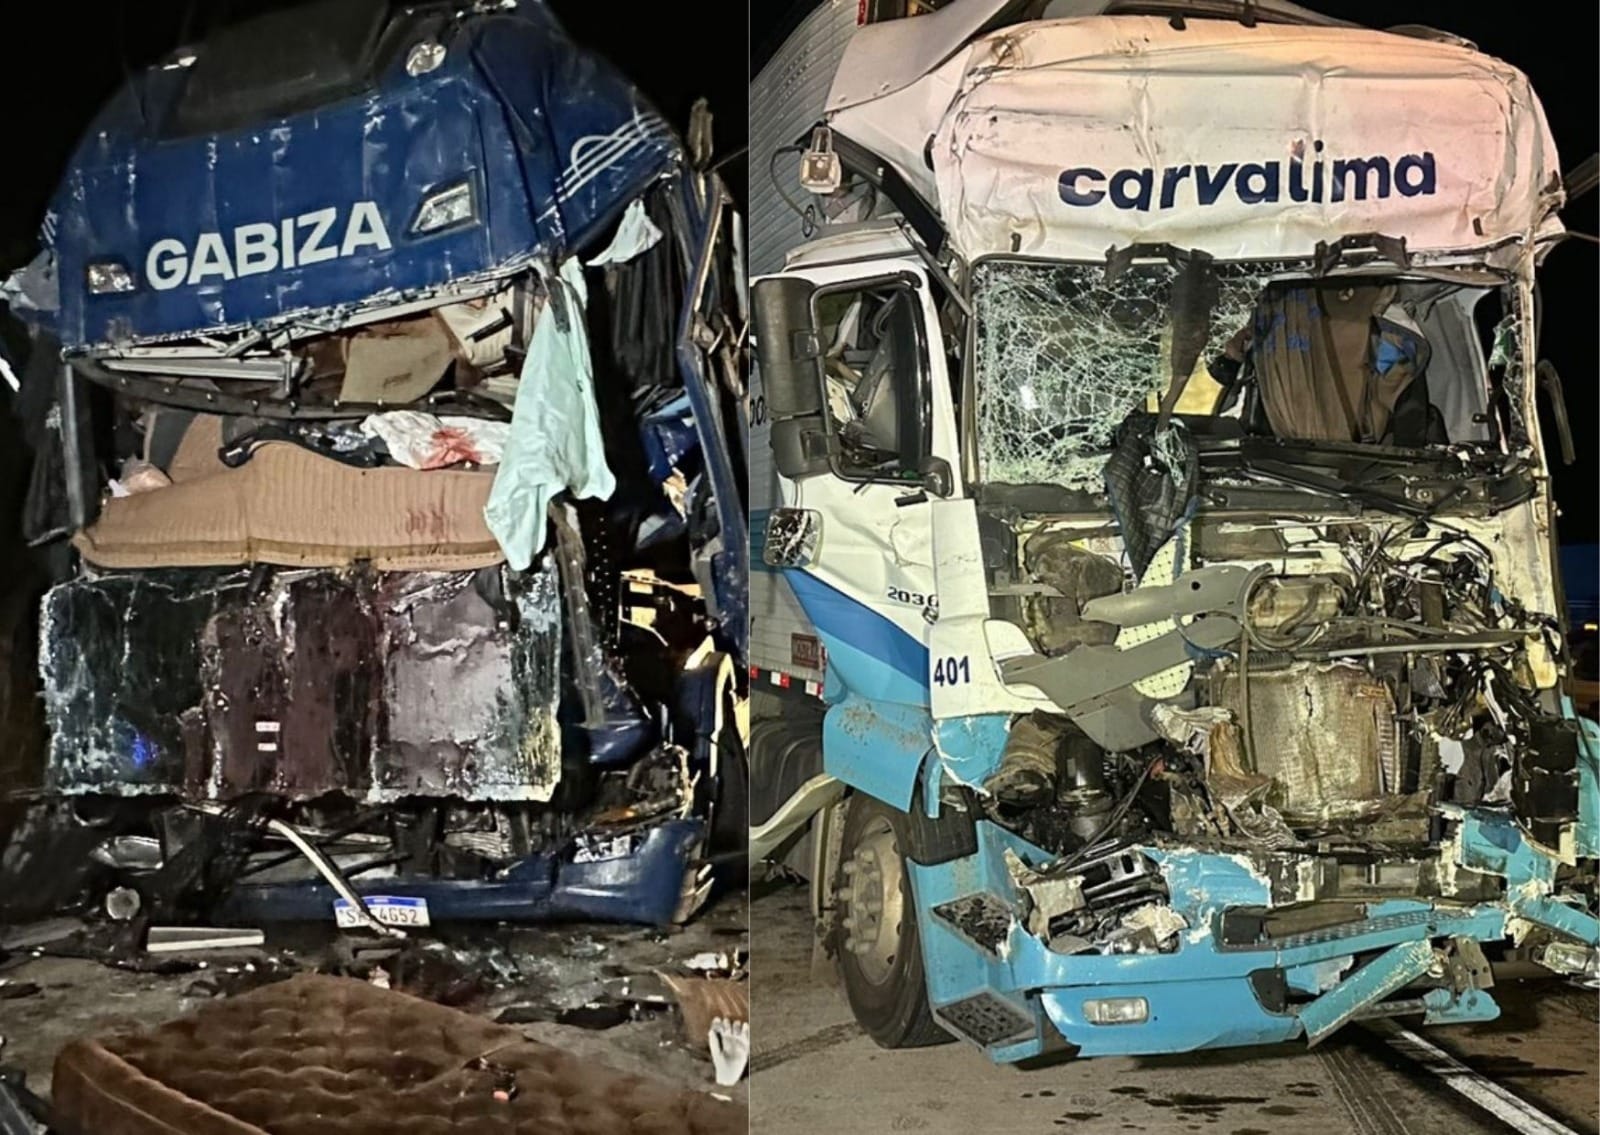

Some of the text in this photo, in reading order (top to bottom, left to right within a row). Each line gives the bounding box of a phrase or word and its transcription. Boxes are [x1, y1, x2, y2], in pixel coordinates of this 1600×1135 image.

[1058, 138, 1436, 211] carvalima
[146, 201, 392, 290] GABIZA
[933, 655, 970, 687] 401
